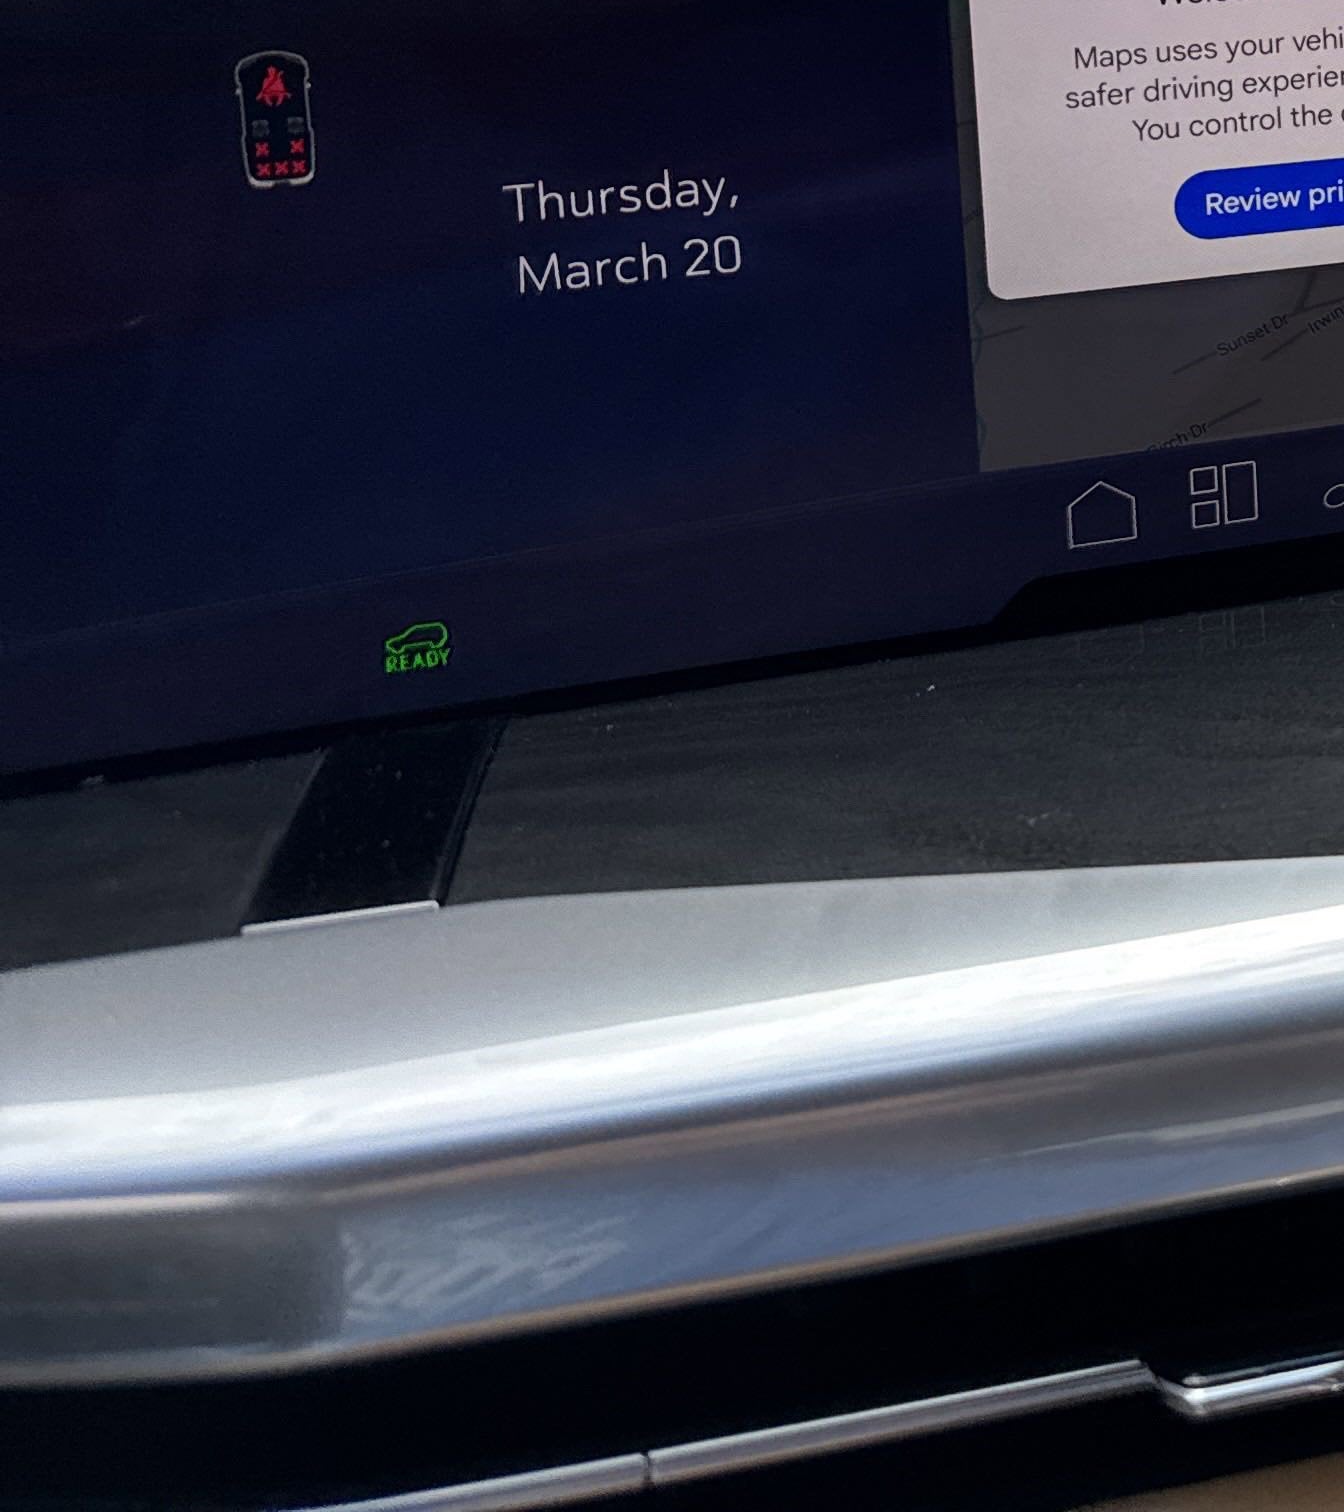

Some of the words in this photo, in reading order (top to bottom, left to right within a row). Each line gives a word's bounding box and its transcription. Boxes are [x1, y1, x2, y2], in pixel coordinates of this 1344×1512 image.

[1075, 46, 1147, 72] Maps
[1157, 43, 1217, 62] uses
[1225, 37, 1284, 63] your
[1066, 82, 1134, 108] safer
[1144, 75, 1232, 102] driving
[1132, 119, 1179, 141] You
[1189, 106, 1281, 136] control
[1290, 104, 1332, 127] the
[503, 169, 738, 221] Thursday,
[1206, 187, 1301, 215] Review
[520, 242, 666, 293] March
[684, 236, 741, 276] 20
[1216, 324, 1270, 356] Sunset
[1271, 313, 1291, 330] Dr
[1308, 309, 1344, 336] Irwin
[1189, 420, 1209, 440] Dr
[386, 648, 451, 673] READY
